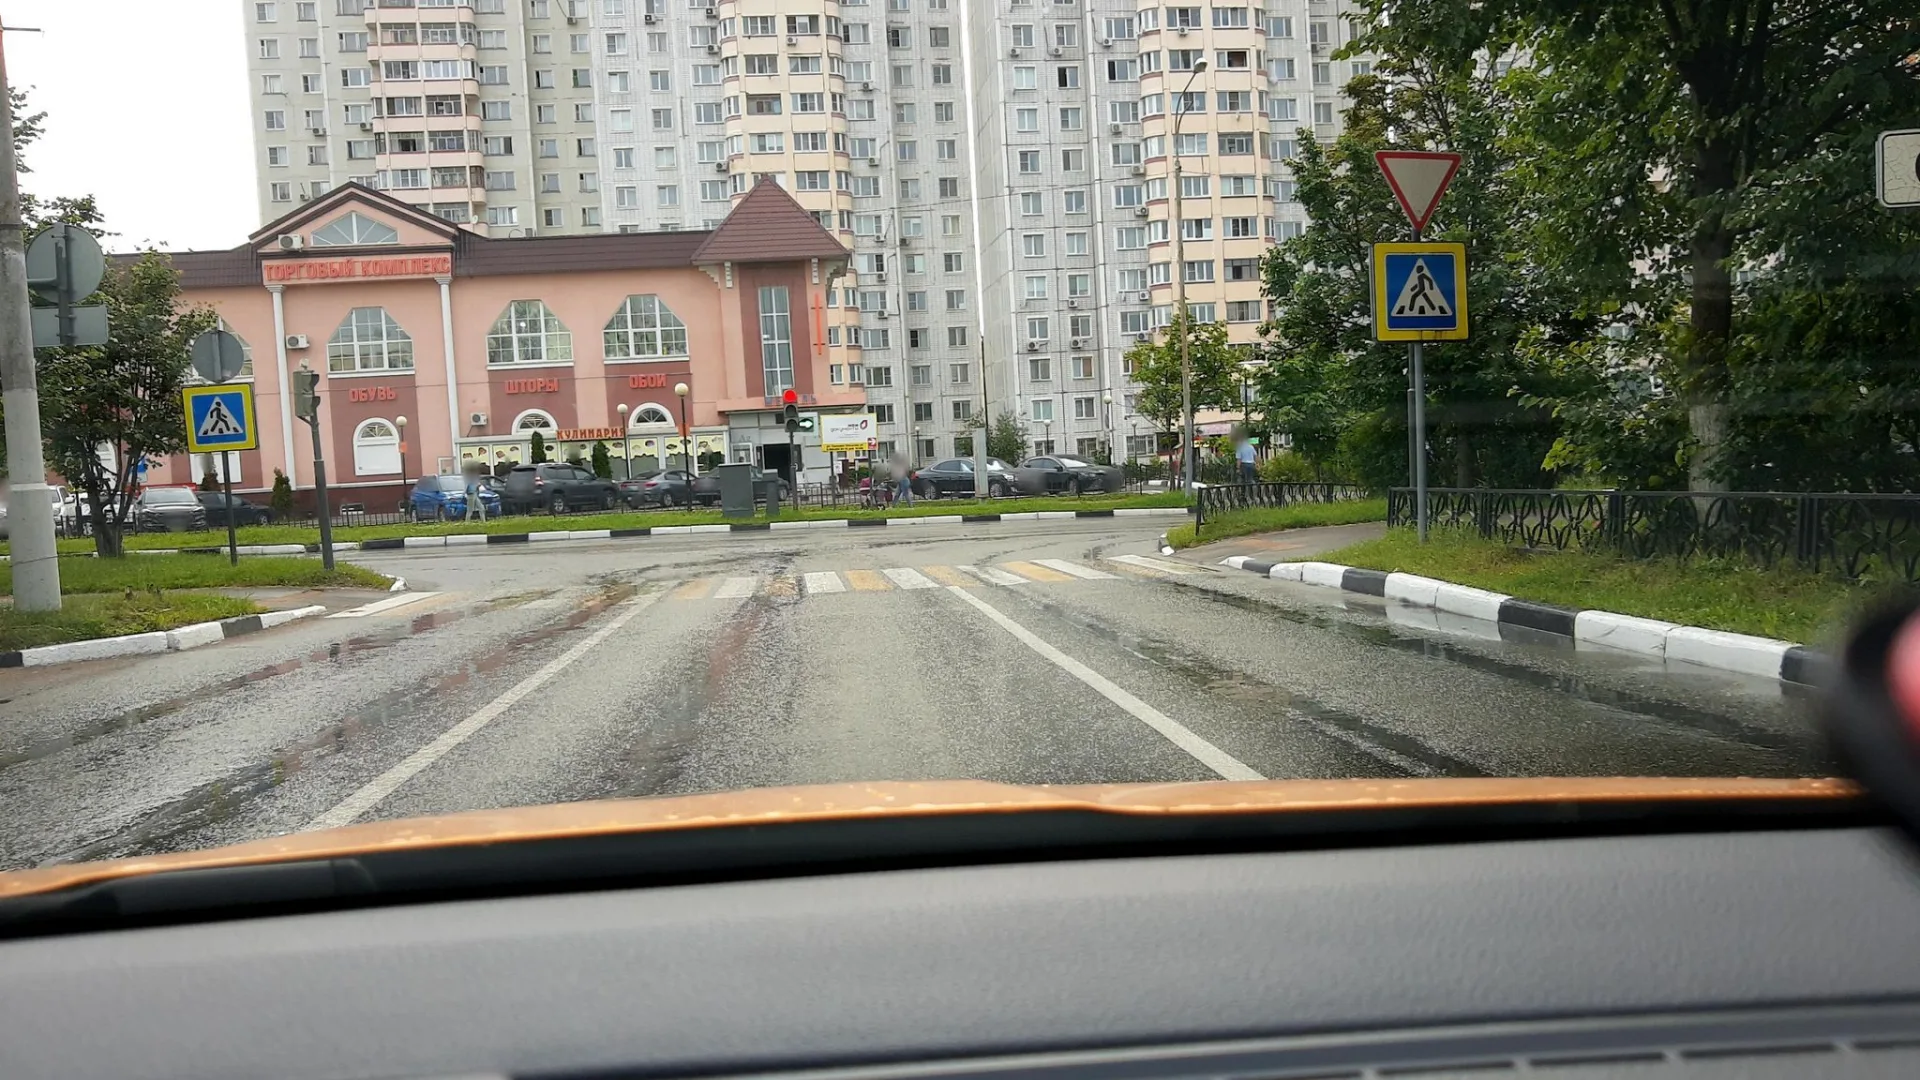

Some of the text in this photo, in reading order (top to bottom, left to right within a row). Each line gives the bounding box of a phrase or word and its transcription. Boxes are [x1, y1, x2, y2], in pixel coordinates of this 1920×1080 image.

[264, 257, 450, 281] ТОРГОВЫЙ КОМПЛЕКС
[350, 386, 396, 402] ОБУВЬ
[505, 378, 559, 394] ШТОРЫ
[556, 427, 624, 441] КУЛИНАРИЯ
